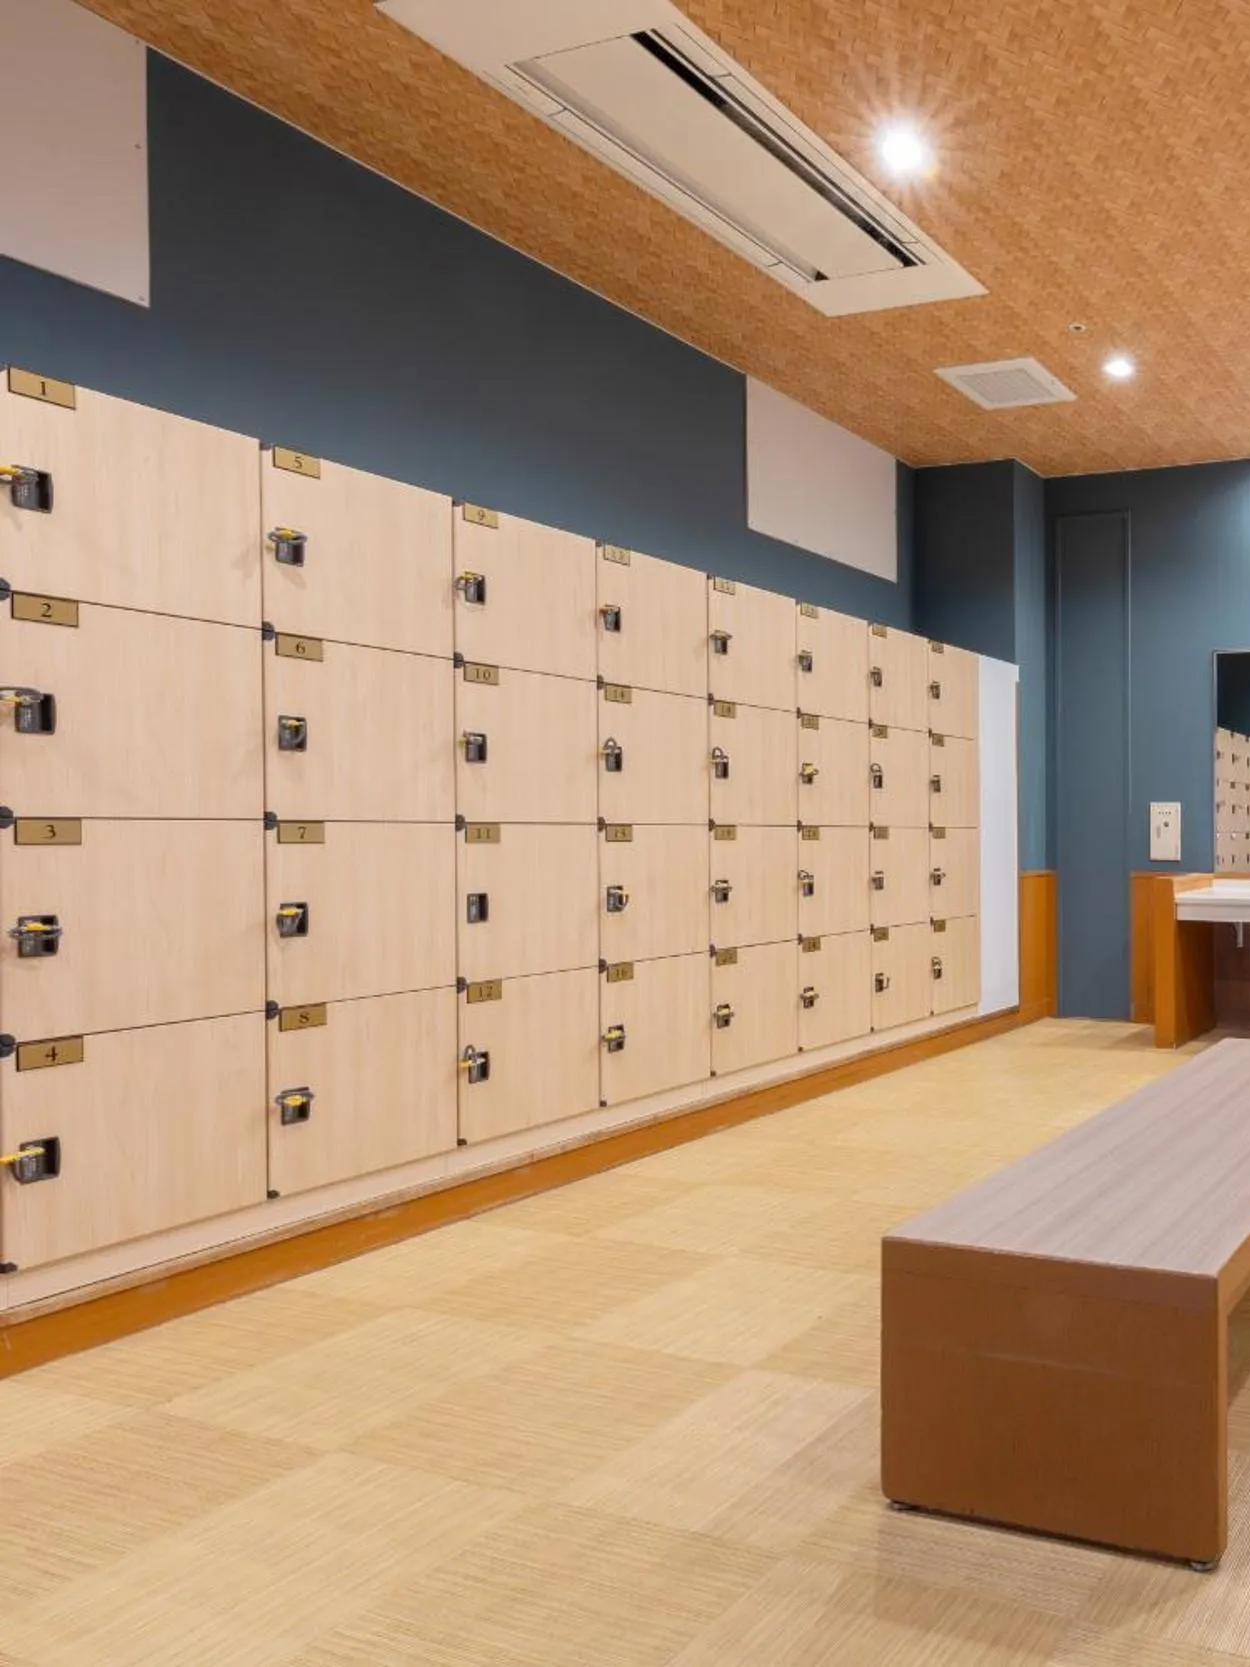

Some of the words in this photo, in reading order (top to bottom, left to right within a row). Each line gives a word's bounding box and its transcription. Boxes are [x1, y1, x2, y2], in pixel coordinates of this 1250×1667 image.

[40, 381, 46, 395] 1
[293, 456, 303, 469] 5
[478, 510, 485, 521] 9
[40, 603, 52, 618] 2
[296, 641, 306, 655] 6
[474, 668, 491, 681] 10
[45, 824, 57, 839] 3
[297, 826, 307, 840] 7
[476, 828, 492, 840] 11
[478, 985, 493, 998] 12
[299, 1012, 310, 1024] 8
[45, 1046, 58, 1062] 4
